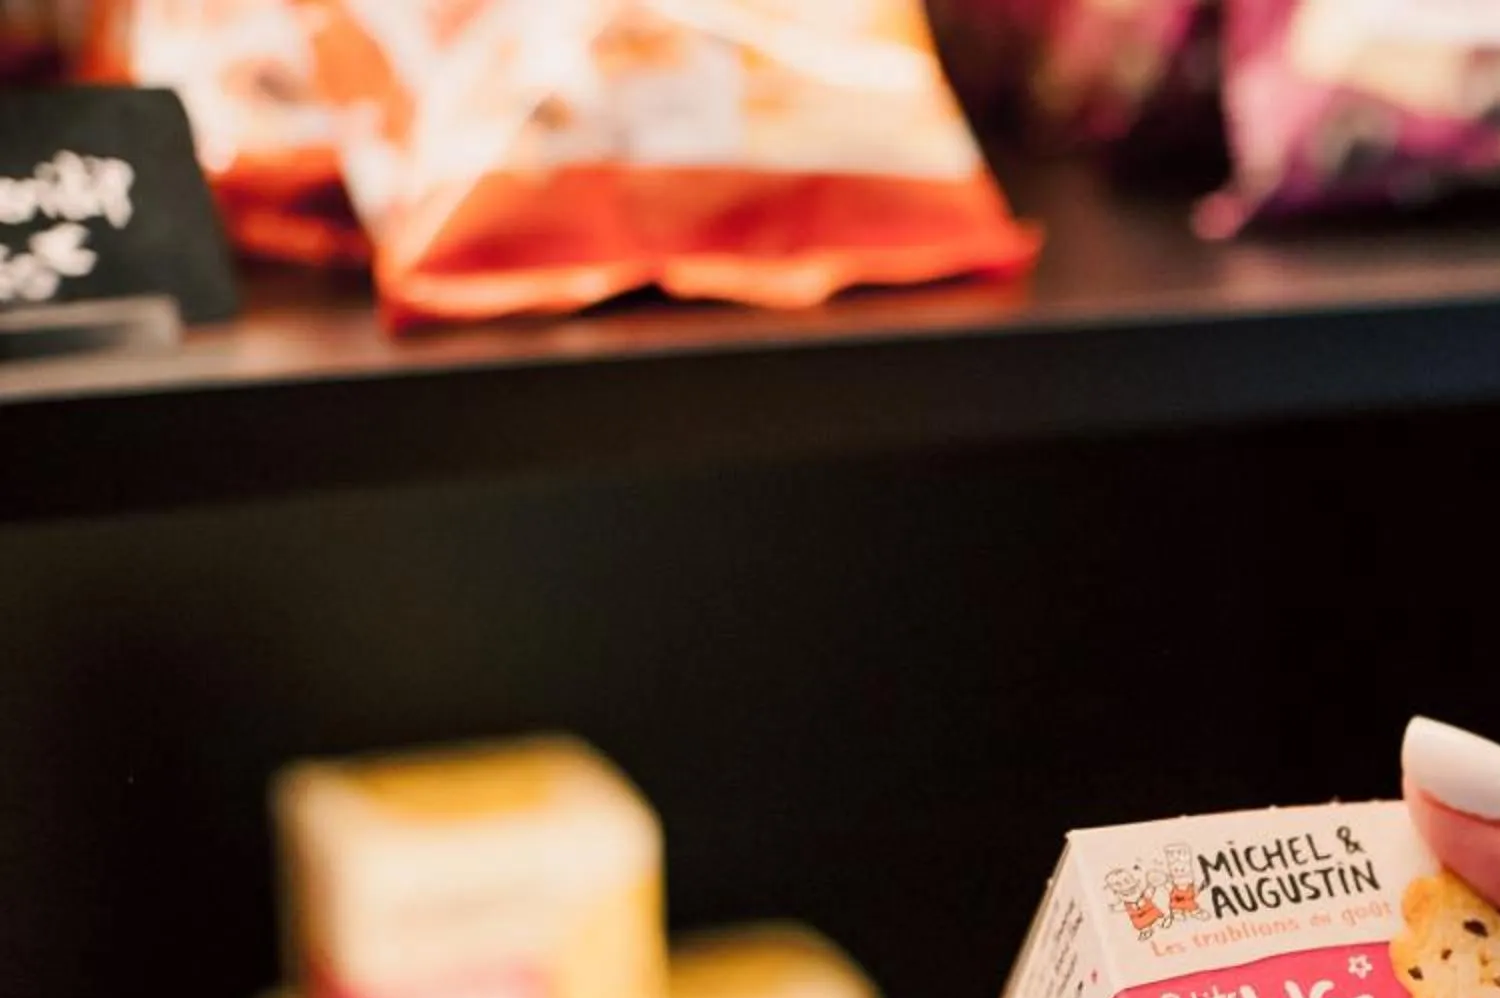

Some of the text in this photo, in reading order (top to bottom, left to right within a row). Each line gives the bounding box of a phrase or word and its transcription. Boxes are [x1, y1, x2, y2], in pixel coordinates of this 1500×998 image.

[1197, 826, 1367, 891] MICHEL &
[1210, 860, 1381, 919] AUGUSTIN
